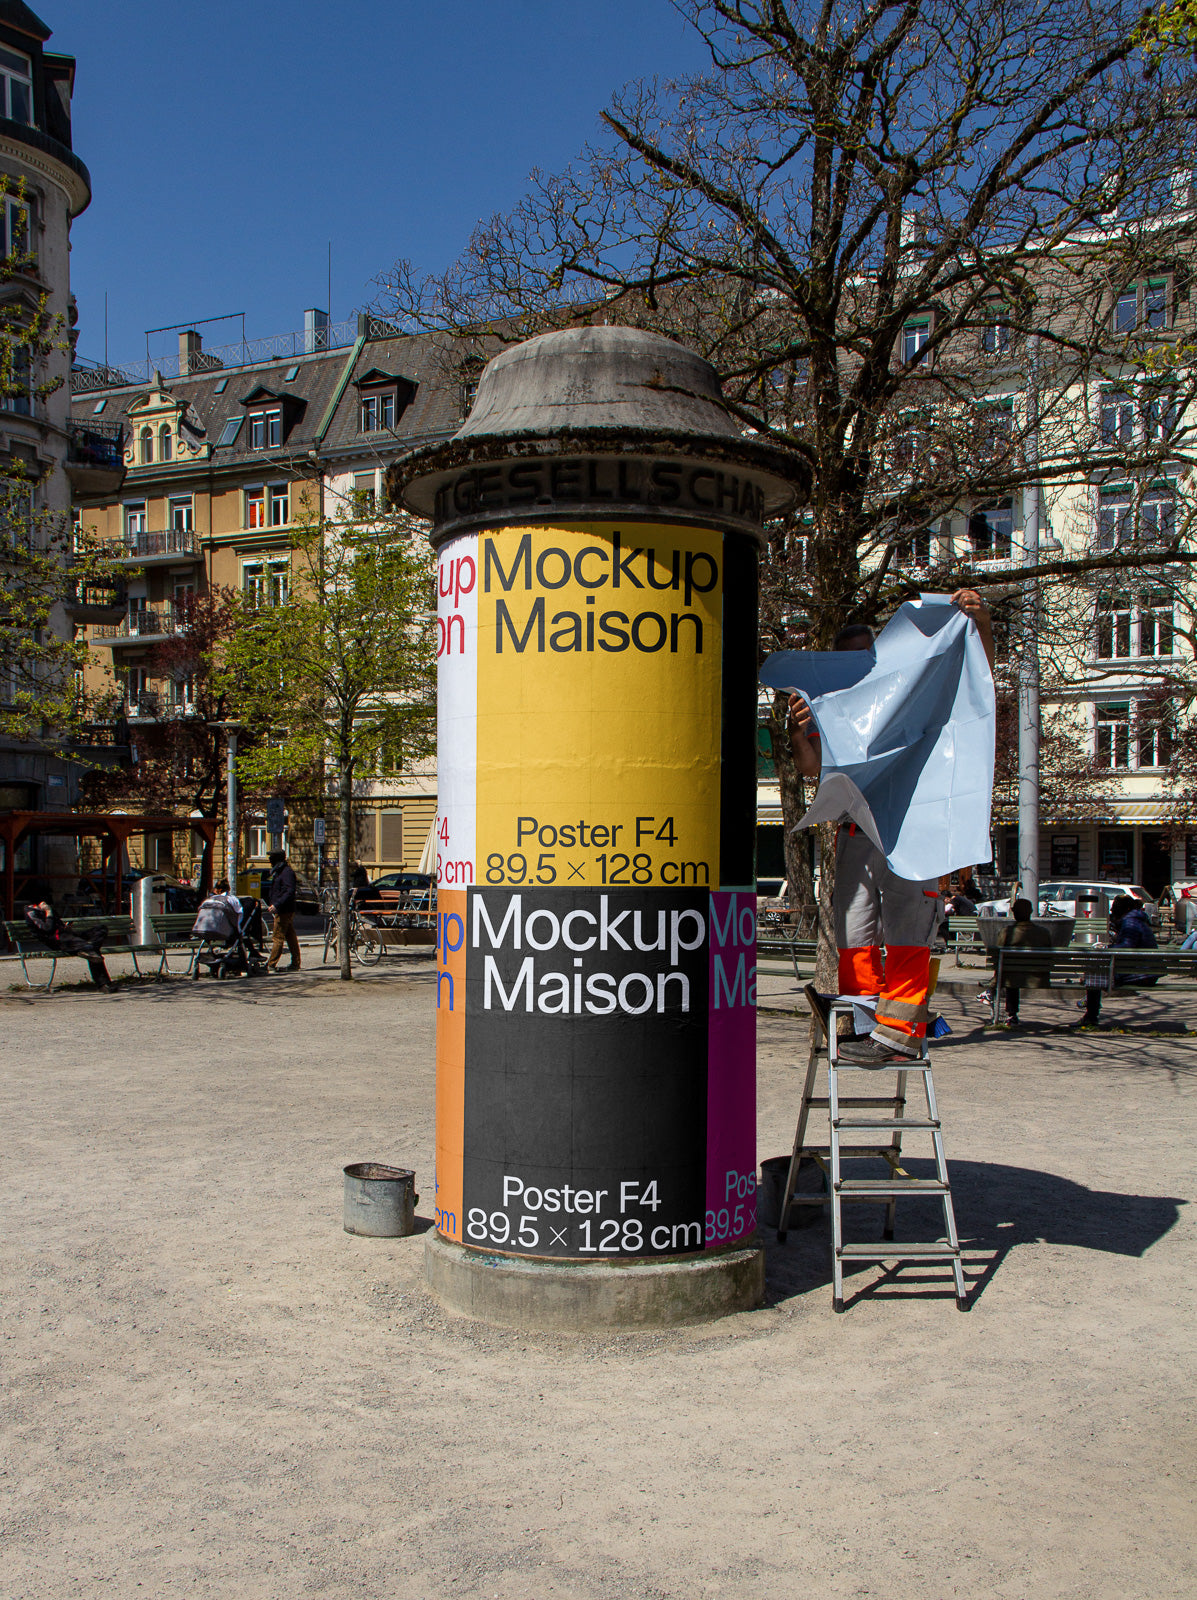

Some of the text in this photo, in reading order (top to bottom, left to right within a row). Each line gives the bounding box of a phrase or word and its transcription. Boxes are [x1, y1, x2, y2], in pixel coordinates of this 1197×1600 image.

[437, 555, 476, 609] up
[484, 531, 718, 606] Mockup
[495, 596, 703, 656] Maison
[517, 816, 678, 848] Poster F4
[445, 861, 473, 884] cm
[485, 853, 557, 885] 89.5
[595, 853, 653, 885] 128
[660, 861, 709, 884] cm
[472, 893, 706, 966] Mockup
[483, 954, 690, 1015] Maison
[503, 1175, 662, 1213] Poster F4
[466, 1207, 540, 1249] 89.5
[577, 1219, 644, 1252] 128
[650, 1221, 702, 1249] cm
[705, 1204, 744, 1241] 89.5
